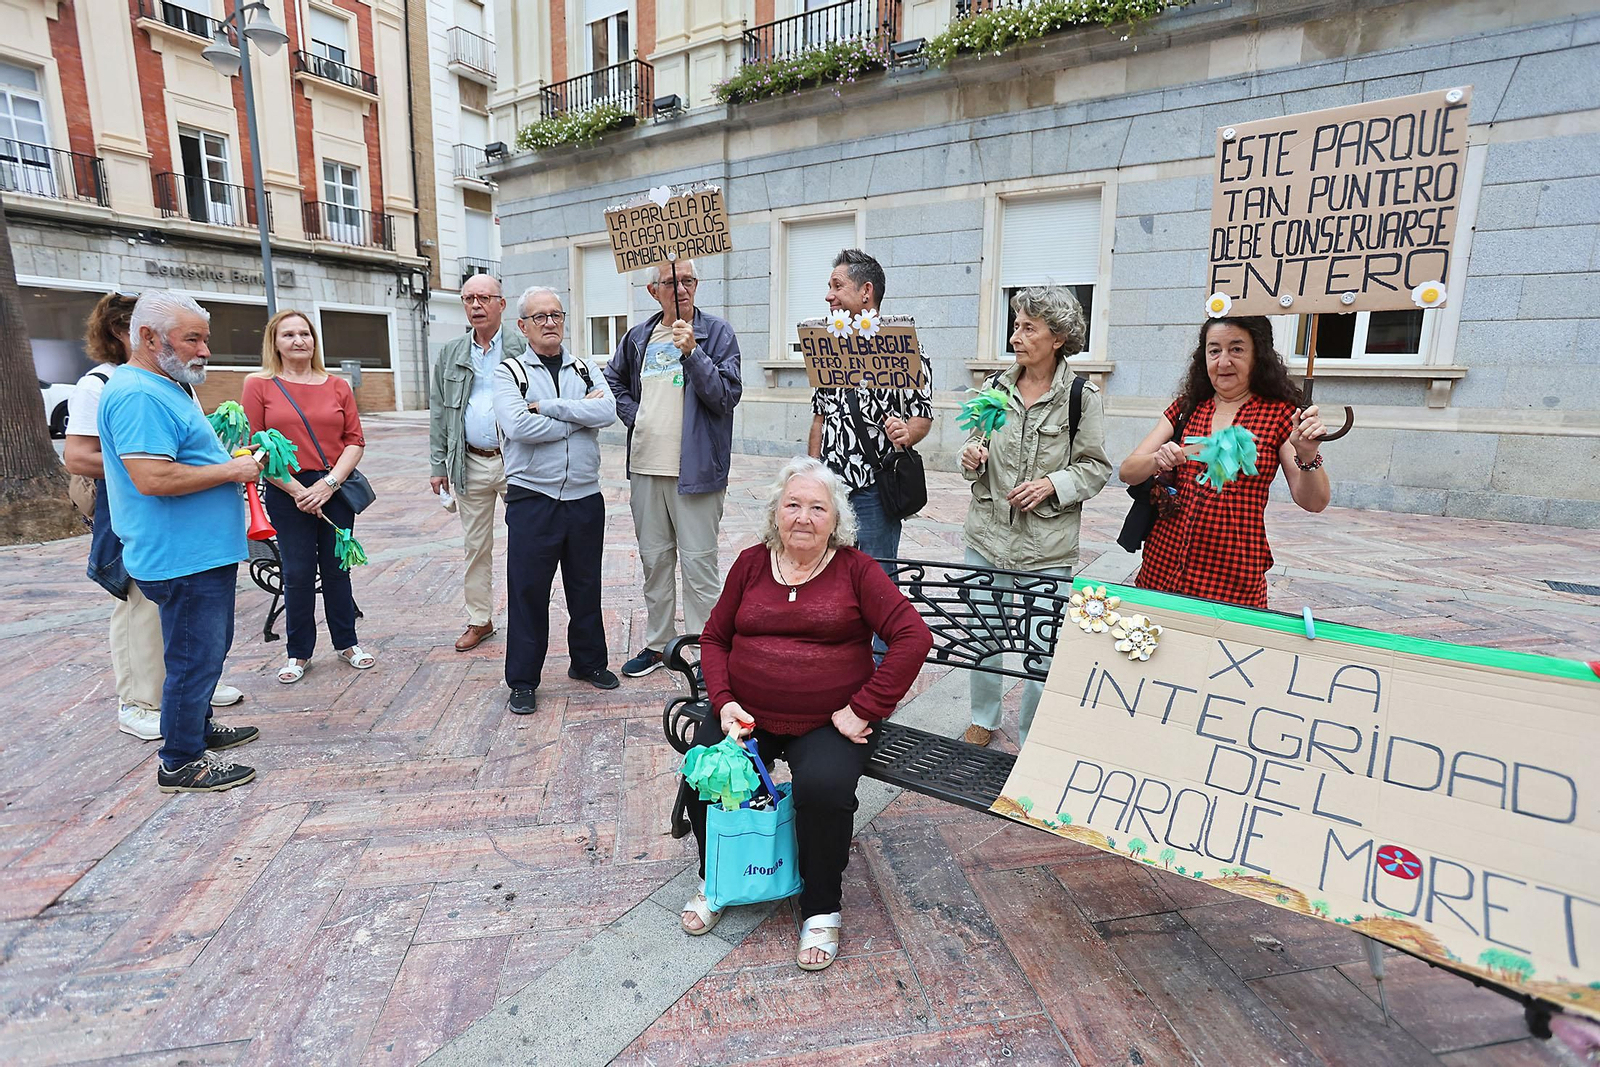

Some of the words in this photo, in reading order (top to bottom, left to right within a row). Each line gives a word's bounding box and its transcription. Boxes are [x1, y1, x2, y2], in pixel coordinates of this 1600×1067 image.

[1220, 130, 1297, 183] ESTE
[1310, 104, 1467, 171] PARQUE
[610, 214, 627, 231] LA
[630, 198, 698, 227] PARCELA
[701, 193, 720, 213] DE
[1223, 185, 1291, 222] TAN
[1308, 162, 1458, 214] PUNTERO
[611, 231, 629, 250] LA
[630, 223, 666, 248] CASA
[668, 213, 725, 240] DUCLÓS
[617, 244, 668, 270] TAMBIEN
[676, 232, 731, 258] PARQUE
[1210, 222, 1265, 263] DEBE
[145, 260, 225, 280] Deutsche
[1210, 248, 1450, 300] ENTERO
[819, 336, 839, 356] AL
[838, 334, 916, 356] ALBERGUE
[849, 356, 866, 370] EN
[872, 356, 909, 370] OTRA
[1208, 639, 1265, 688] X
[1286, 654, 1381, 713] LA
[1204, 744, 1363, 827] DEL
[1055, 760, 1284, 875] PARQUE
[1318, 828, 1600, 969] MORET
